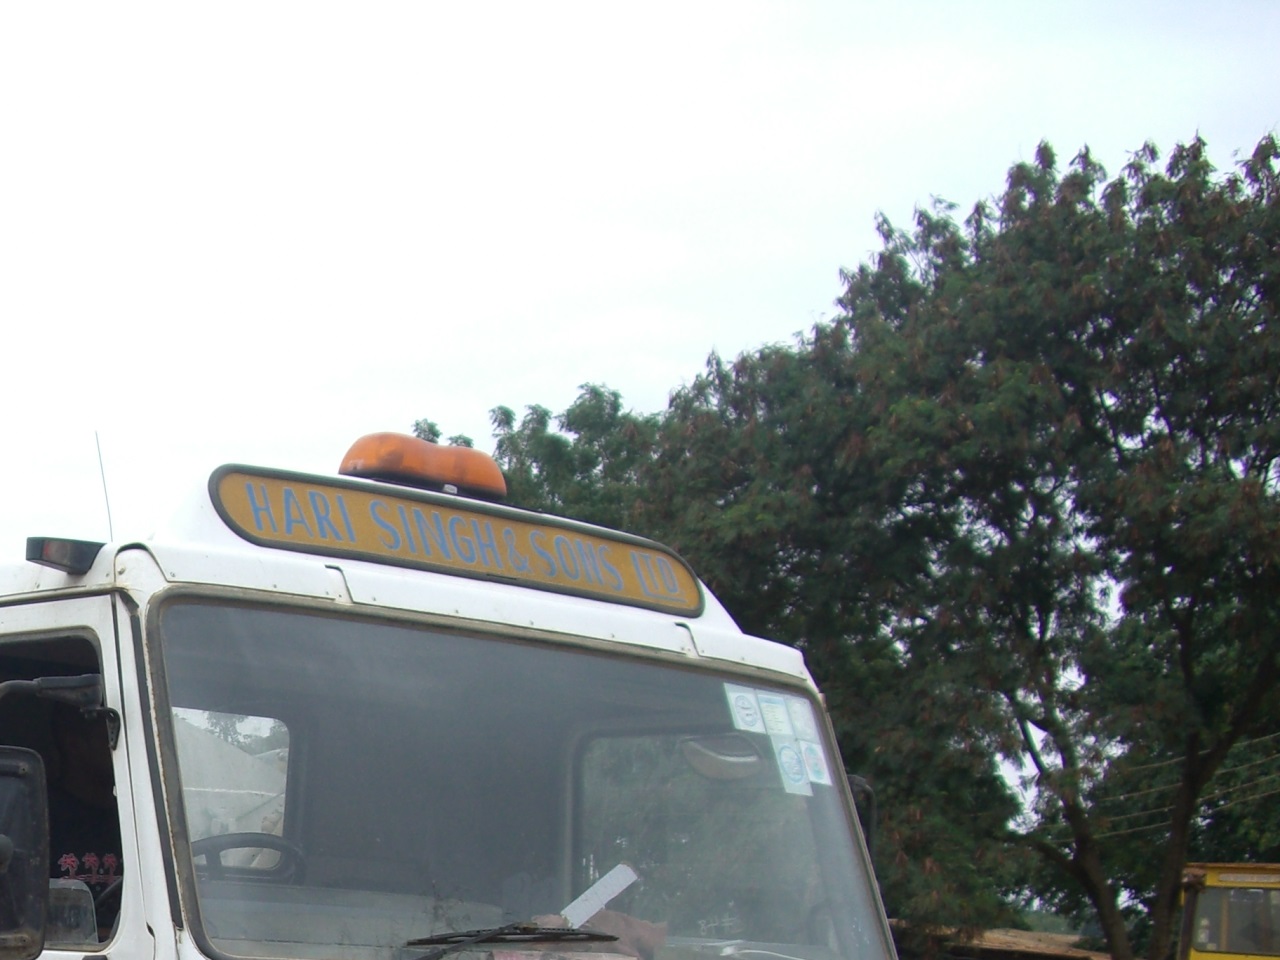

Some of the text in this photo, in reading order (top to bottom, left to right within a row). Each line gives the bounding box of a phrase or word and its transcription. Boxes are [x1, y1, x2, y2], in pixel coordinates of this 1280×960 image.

[244, 482, 357, 543] HARI
[369, 500, 502, 570] SINGH
[530, 531, 624, 590] SONS
[630, 551, 687, 603] LTD
